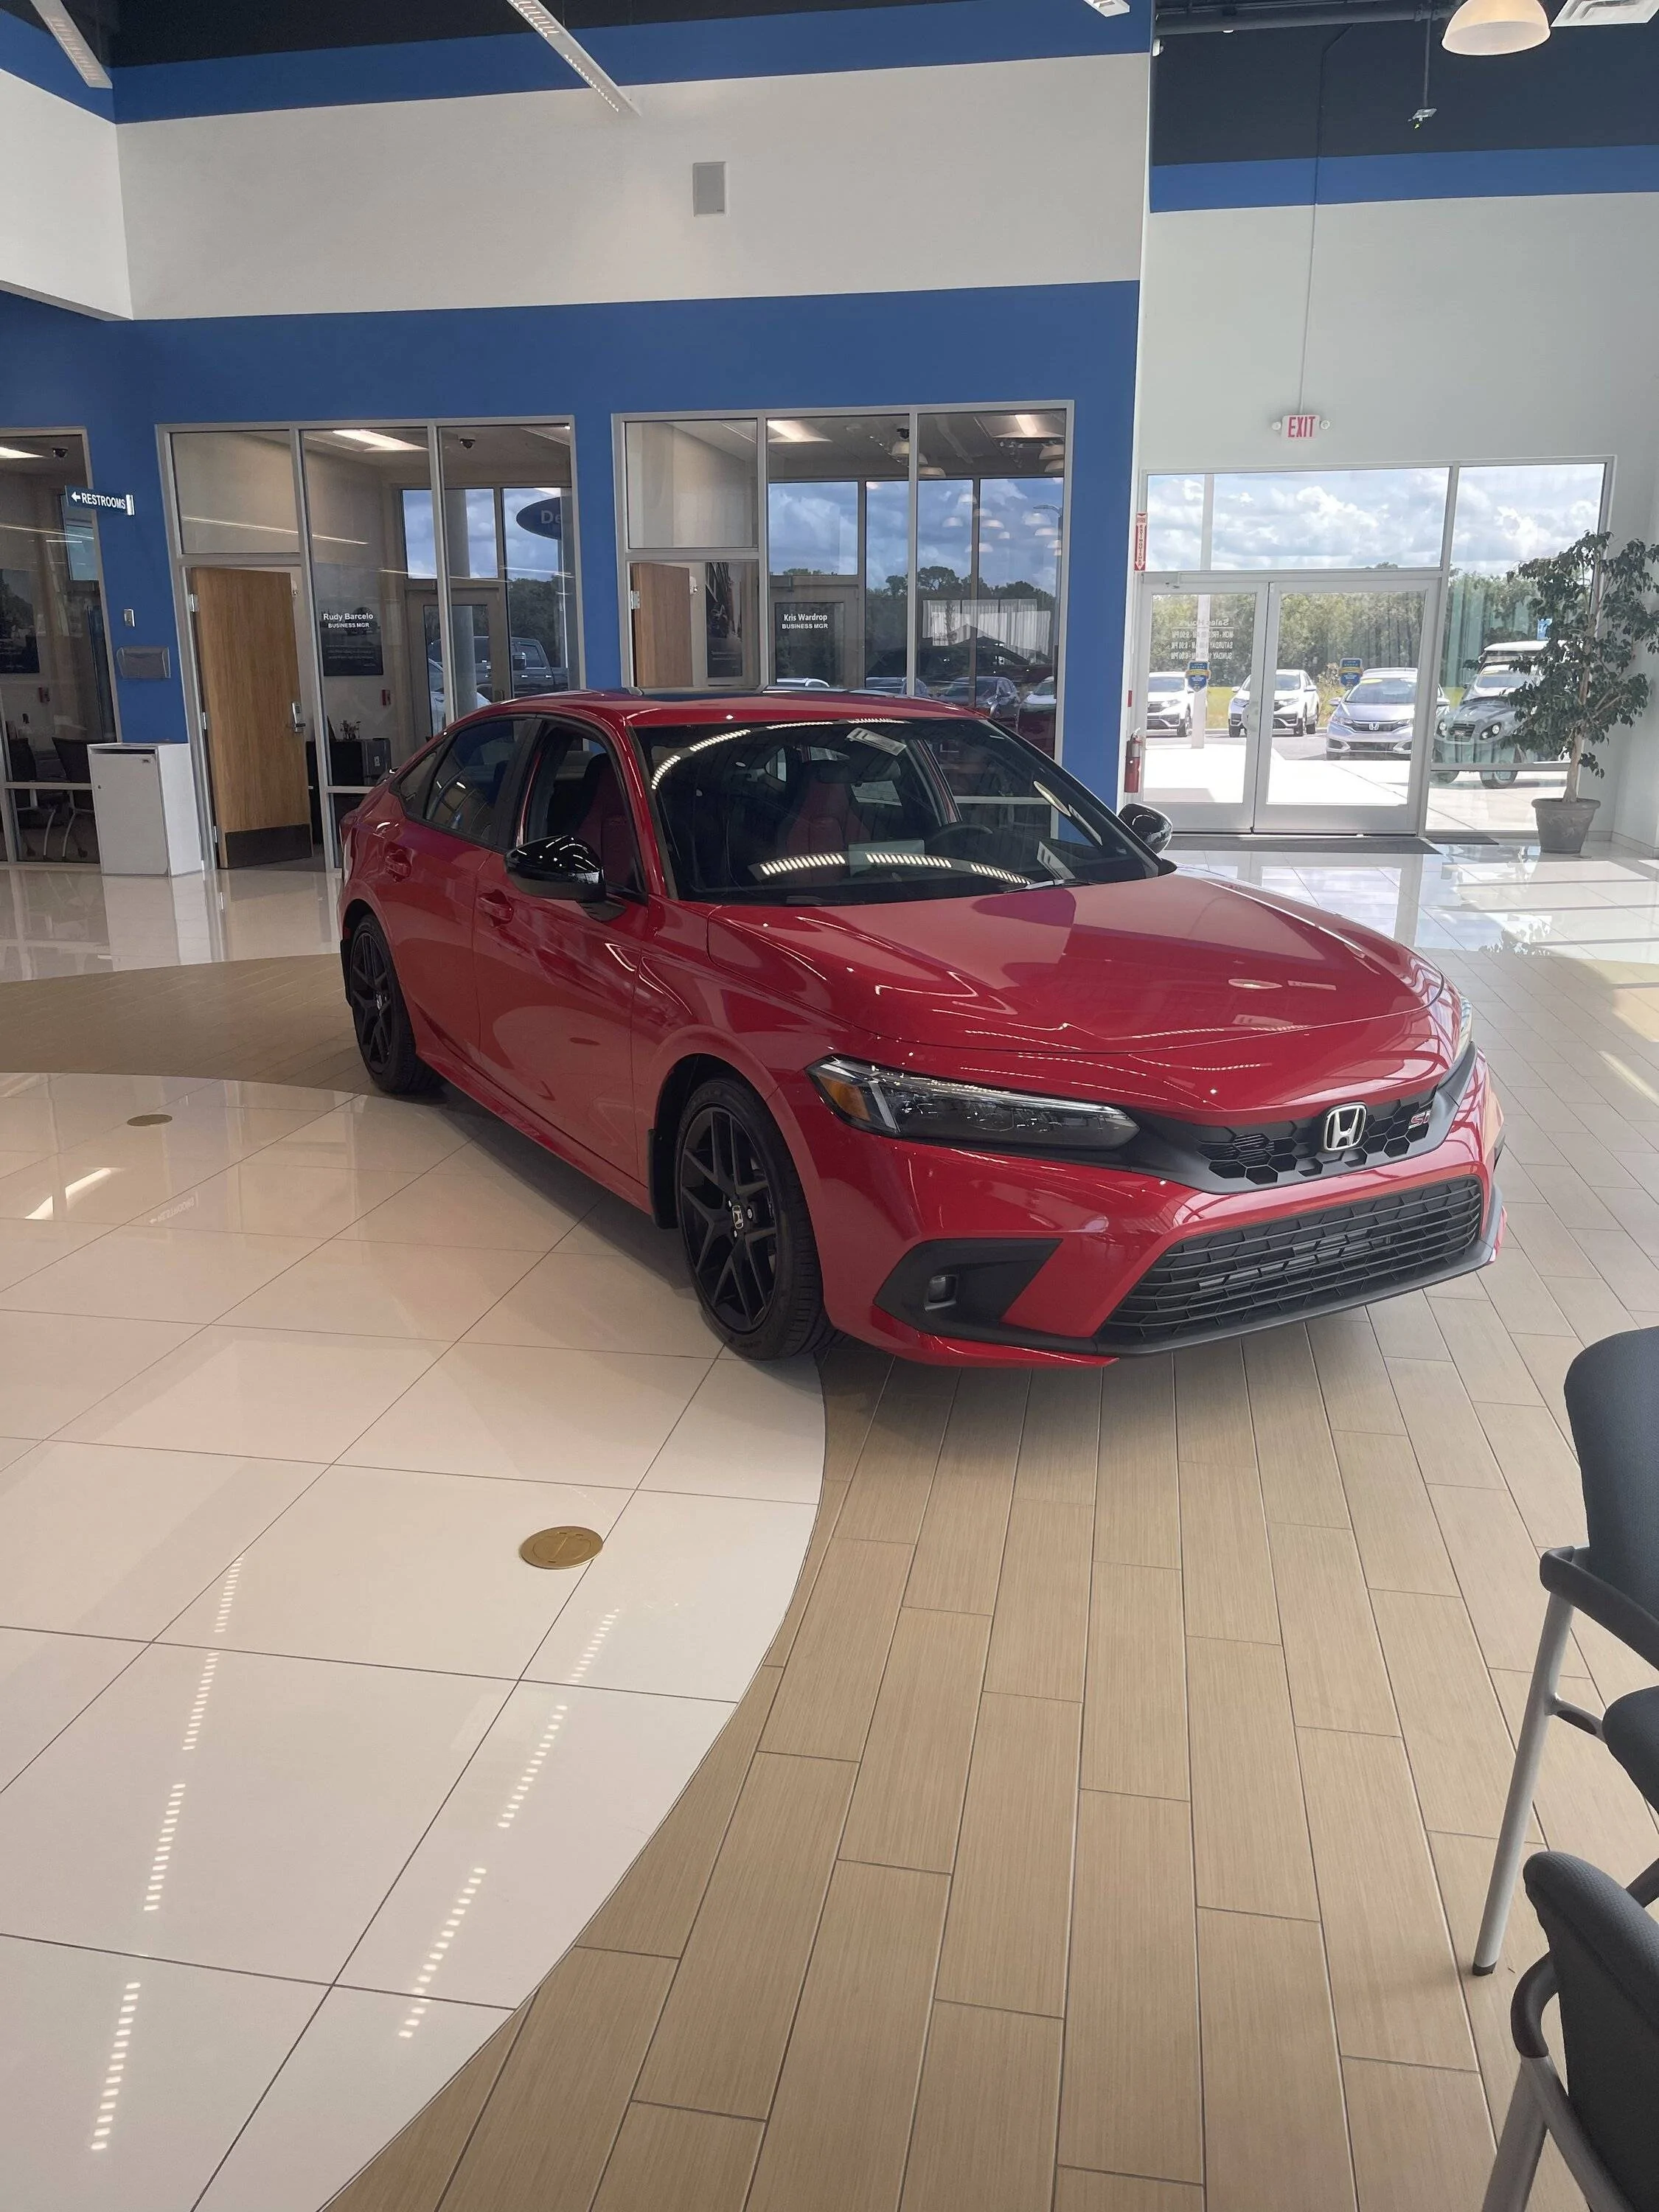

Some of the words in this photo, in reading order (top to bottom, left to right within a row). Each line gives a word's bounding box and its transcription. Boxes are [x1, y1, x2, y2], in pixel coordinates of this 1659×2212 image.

[1287, 416, 1316, 438] EXIT
[81, 492, 126, 509] RESTROOMS
[323, 613, 343, 622] Rudy
[798, 613, 828, 622] Wardrop
